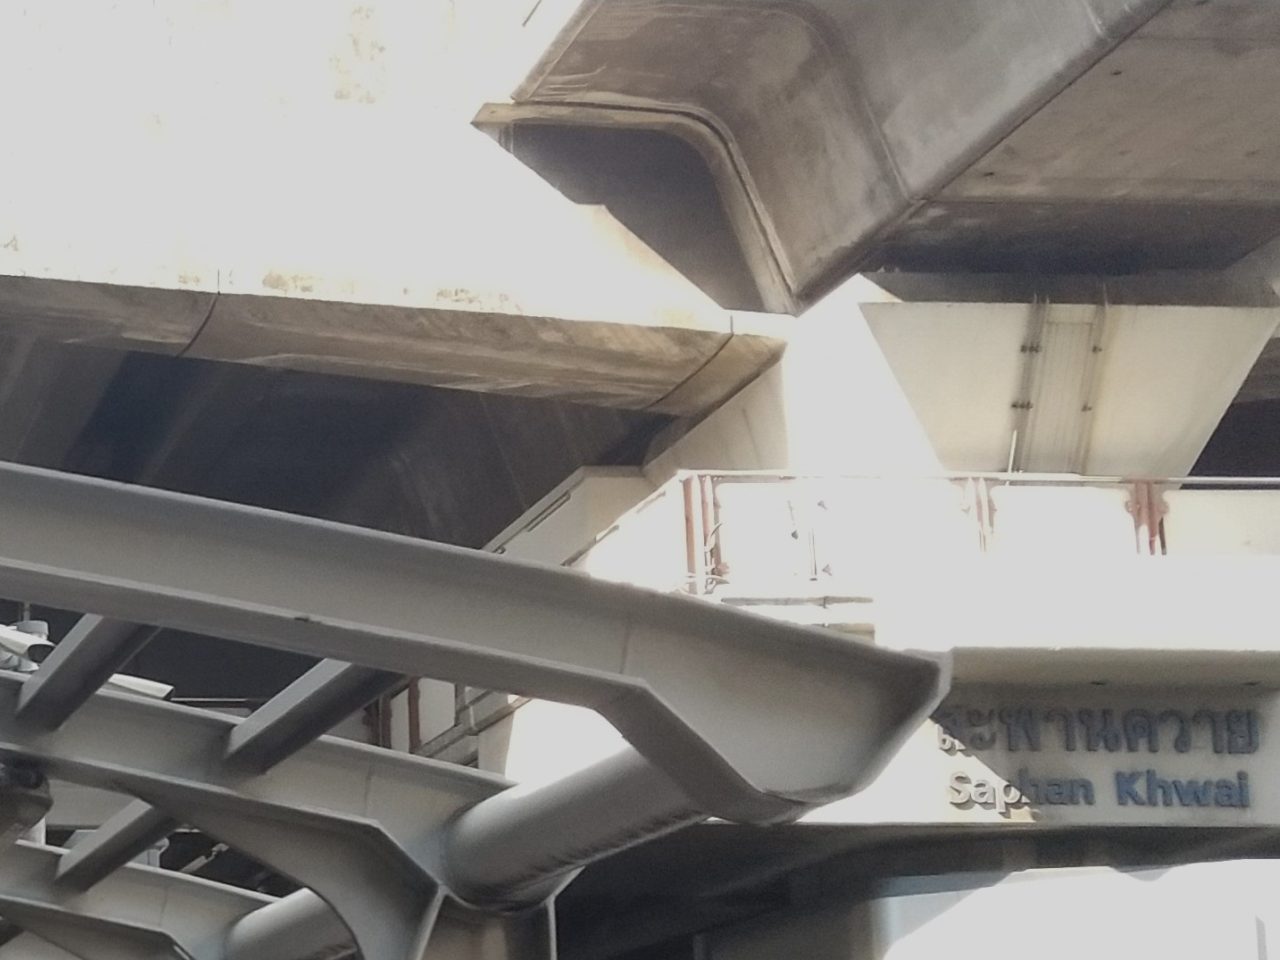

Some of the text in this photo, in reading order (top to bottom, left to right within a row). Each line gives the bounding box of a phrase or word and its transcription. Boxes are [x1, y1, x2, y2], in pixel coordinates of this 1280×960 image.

[931, 706, 1260, 754] สะพานควาย
[949, 769, 1251, 813] Saphan Khwai
